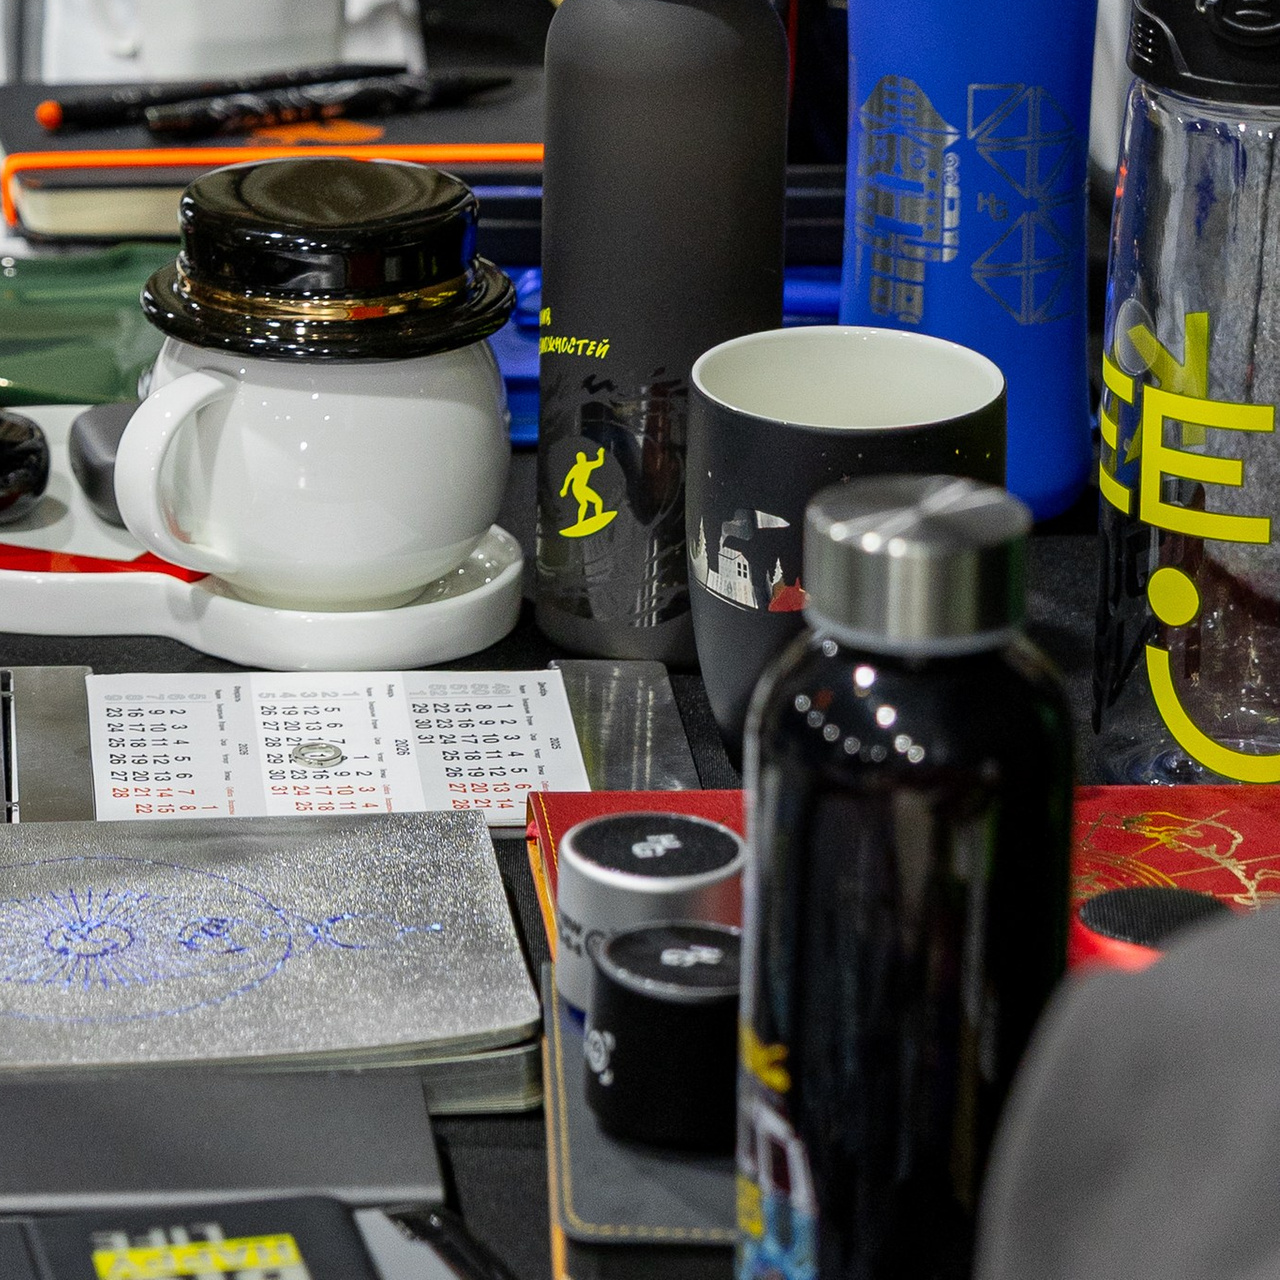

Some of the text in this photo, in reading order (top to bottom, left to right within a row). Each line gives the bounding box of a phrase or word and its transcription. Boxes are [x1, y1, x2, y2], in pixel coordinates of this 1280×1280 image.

[106, 708, 122, 717] 23
[128, 708, 144, 717] 16
[261, 706, 277, 716] 26
[282, 706, 298, 715] 19
[303, 706, 320, 715] 12
[412, 703, 429, 714] 29
[433, 703, 450, 713] 22
[455, 703, 471, 713] 15
[108, 723, 124, 732] 24
[129, 723, 145, 732] 17
[150, 723, 166, 732] 10
[263, 721, 279, 731] 27
[284, 721, 300, 731] 20
[306, 722, 322, 730] 13
[415, 719, 432, 729] 30
[436, 719, 453, 729] 23
[458, 719, 474, 728] 16
[108, 738, 125, 748] 25
[130, 738, 146, 747] 18
[152, 738, 168, 746] 11
[265, 737, 280, 747] 28
[418, 735, 435, 744] 31
[439, 734, 456, 744] 24
[461, 734, 478, 744] 17
[482, 734, 499, 743] 10
[395, 739, 410, 755] 2026
[110, 754, 126, 764] 26
[132, 754, 148, 764] 19
[153, 754, 169, 764] 12
[267, 754, 284, 764] 29
[442, 751, 460, 761] 25
[464, 751, 481, 760] 18
[486, 750, 503, 758] 11
[133, 771, 149, 781] 20
[154, 771, 171, 781] 13
[269, 770, 286, 780] 30
[291, 770, 307, 780] 23
[312, 770, 329, 779] 16
[445, 767, 463, 778] 26
[468, 767, 484, 777] 19
[489, 766, 506, 776] 12
[111, 771, 128, 782] 27
[272, 786, 288, 795] 31
[293, 786, 310, 796] 24
[315, 786, 332, 796] 17
[337, 786, 354, 794] 10
[449, 783, 467, 793] 27
[471, 783, 488, 792] 20
[493, 782, 510, 792] 13
[112, 788, 129, 798] 28
[134, 788, 151, 797] 21
[156, 788, 173, 797] 14
[136, 804, 152, 813] 22
[158, 804, 174, 813] 15
[296, 802, 312, 811] 25
[318, 802, 334, 811] 18
[452, 799, 470, 809] 28
[474, 799, 492, 808] 21
[497, 799, 514, 808] 14
